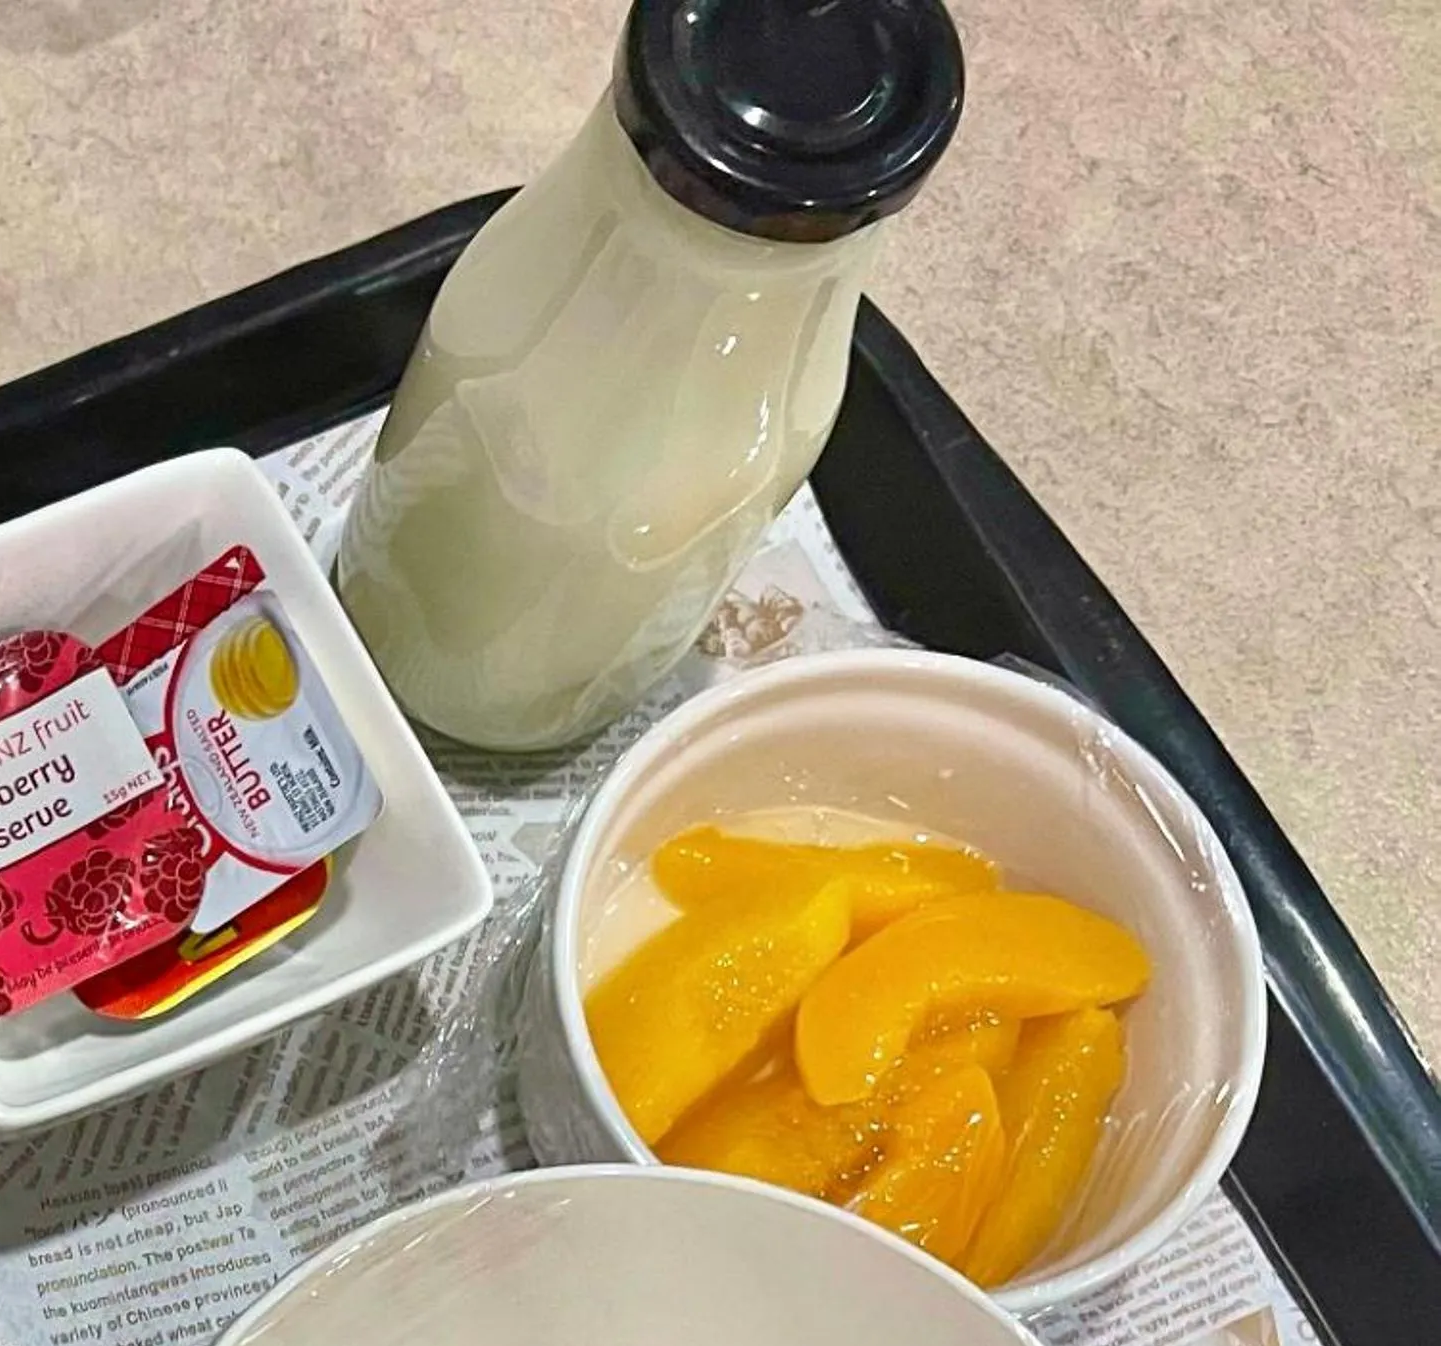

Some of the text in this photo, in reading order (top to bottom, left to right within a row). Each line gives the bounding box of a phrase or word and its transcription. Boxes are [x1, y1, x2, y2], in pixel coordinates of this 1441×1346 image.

[32, 699, 91, 751] fruit
[186, 708, 211, 753] SALTED
[207, 708, 272, 812] BUTTER
[209, 752, 244, 809] ZEALAND
[28, 1247, 74, 1268] bread
[78, 1242, 91, 1257] is
[95, 1234, 123, 1252] not
[127, 1217, 181, 1246] cheap,
[183, 1210, 210, 1228] but
[37, 1259, 142, 1298] pronunciation.
[142, 1247, 174, 1267] The
[177, 1233, 235, 1262] postwar
[43, 1304, 67, 1321] the
[107, 1314, 123, 1332] of
[126, 1300, 192, 1327] Chinese
[169, 1318, 211, 1343] wheat
